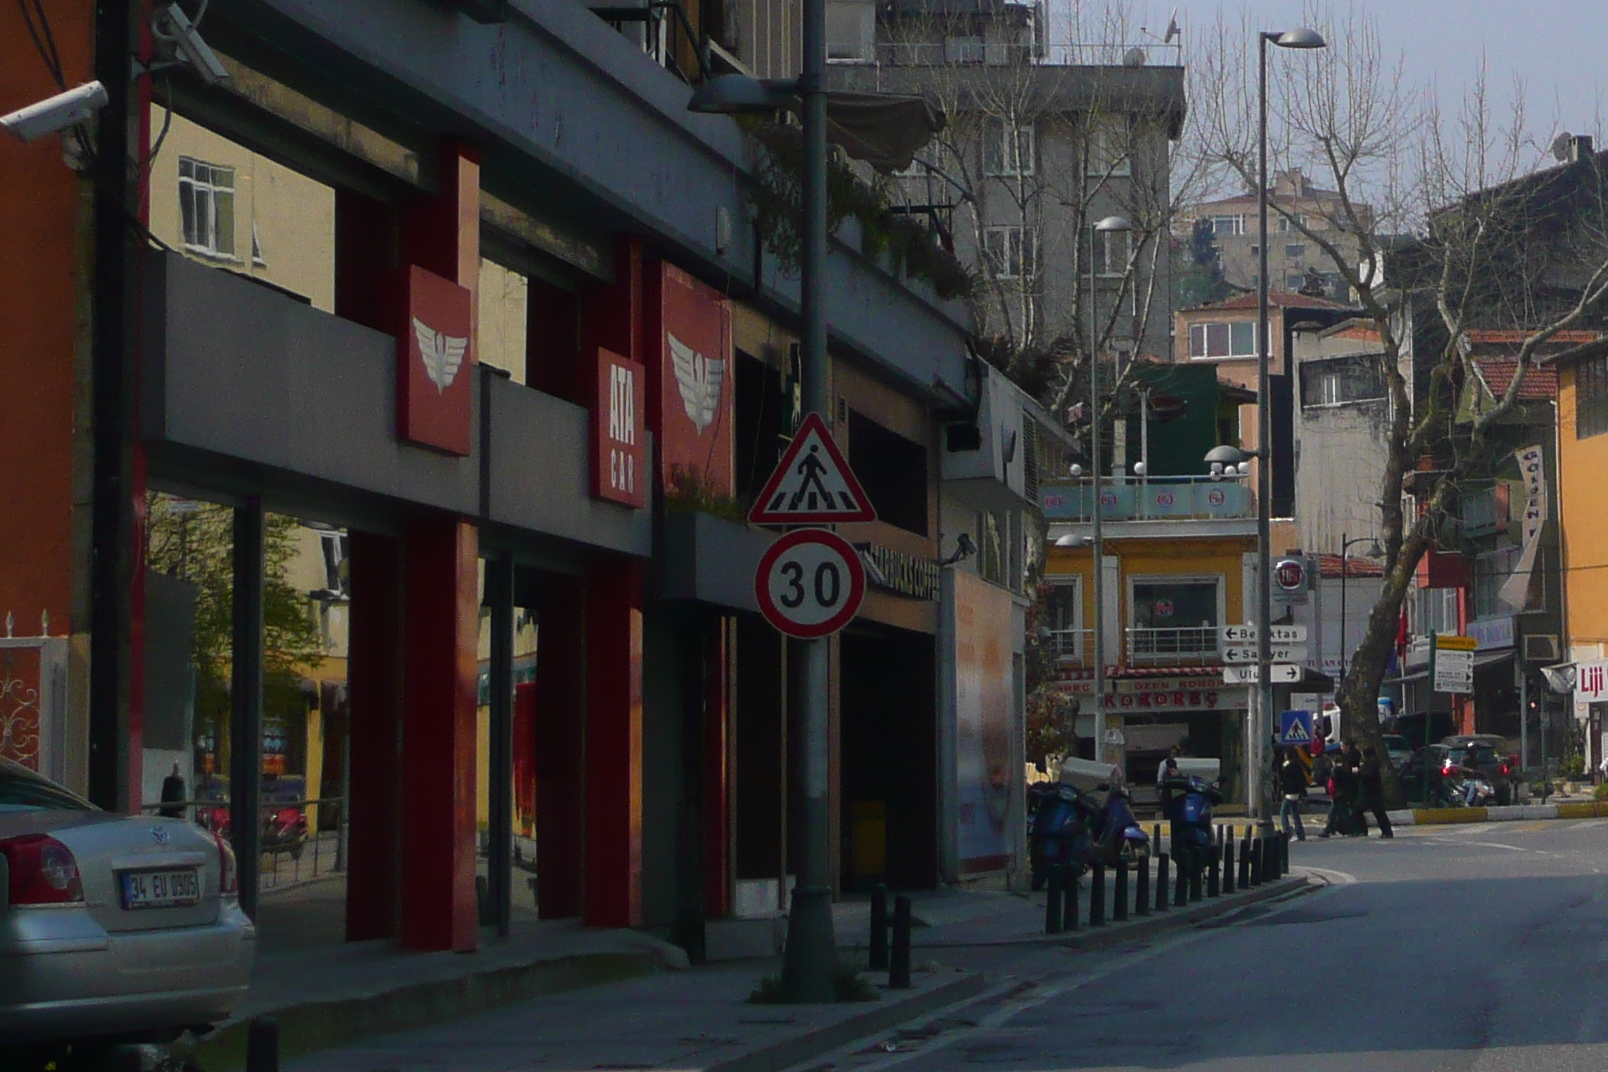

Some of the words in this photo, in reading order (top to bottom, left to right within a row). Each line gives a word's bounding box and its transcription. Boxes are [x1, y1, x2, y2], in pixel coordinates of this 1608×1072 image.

[609, 363, 635, 446] ATA
[610, 448, 634, 495] CAR
[780, 561, 840, 608] 30
[1242, 649, 1290, 660] Sayer
[1104, 691, 1219, 708] KOKOREÇ
